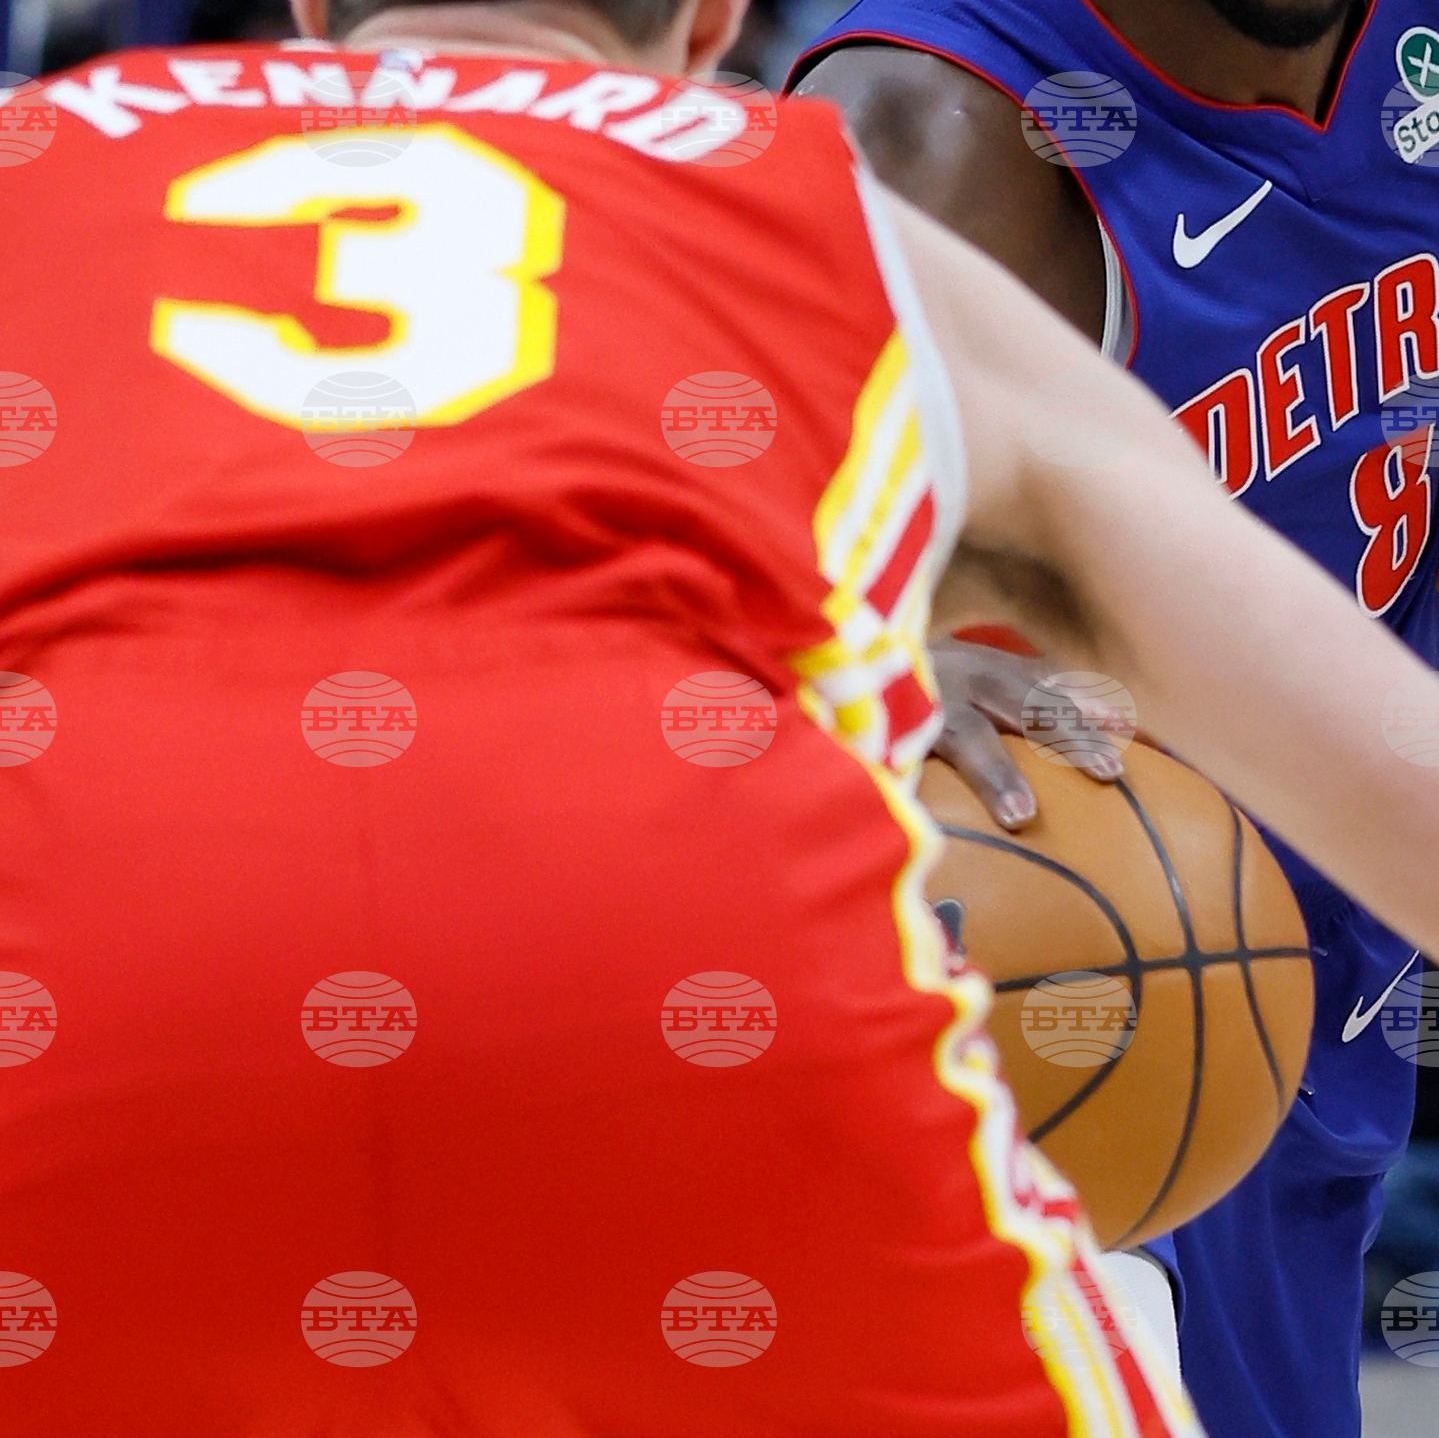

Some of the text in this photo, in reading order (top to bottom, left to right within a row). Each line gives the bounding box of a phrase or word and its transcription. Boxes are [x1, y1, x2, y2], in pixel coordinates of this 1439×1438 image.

[45, 60, 749, 162] KENNARD
[149, 121, 567, 433] 3
[1349, 423, 1436, 619] 8
